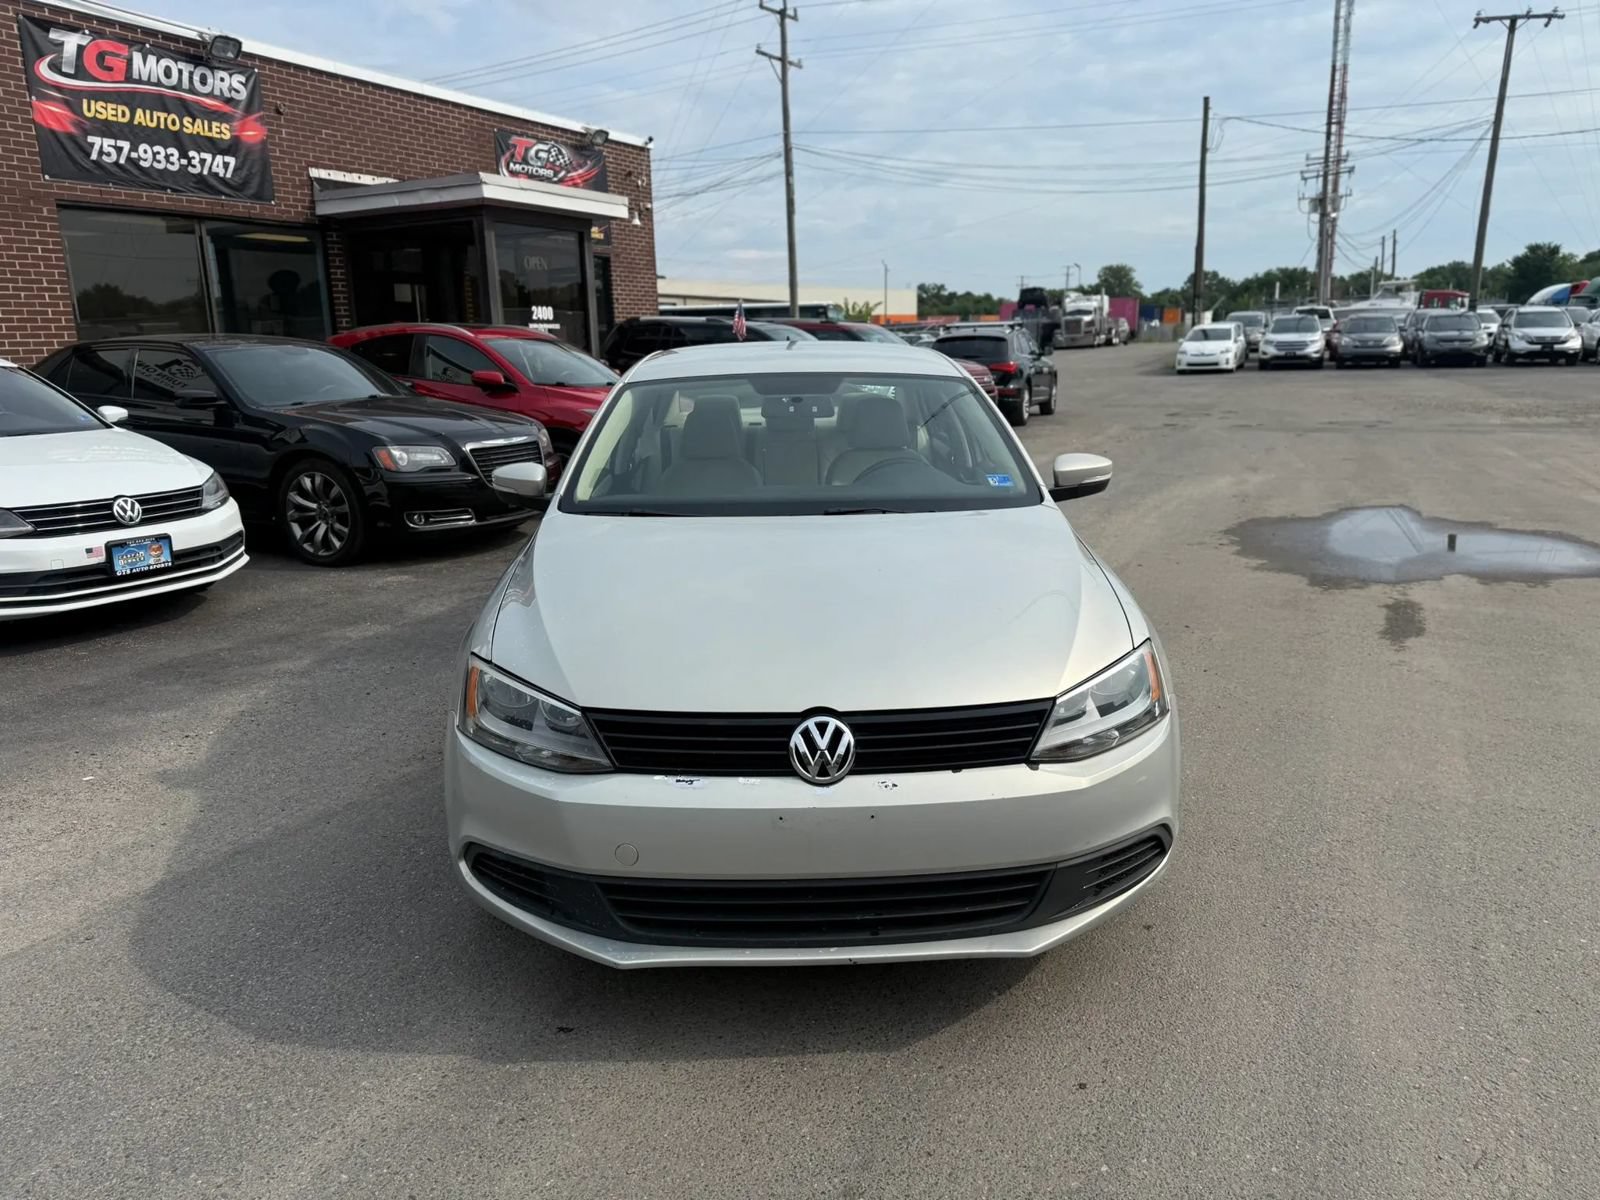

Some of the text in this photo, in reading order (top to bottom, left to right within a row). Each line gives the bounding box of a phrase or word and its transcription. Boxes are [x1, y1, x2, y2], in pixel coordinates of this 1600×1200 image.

[49, 28, 248, 100] TG MOTORS
[82, 98, 232, 140] USED AUTO SALES
[86, 135, 236, 179] 757-933-3747
[509, 136, 550, 167] TG
[509, 161, 554, 178] MOTORS
[531, 305, 554, 321] 2400
[150, 561, 172, 569] SPORTS
